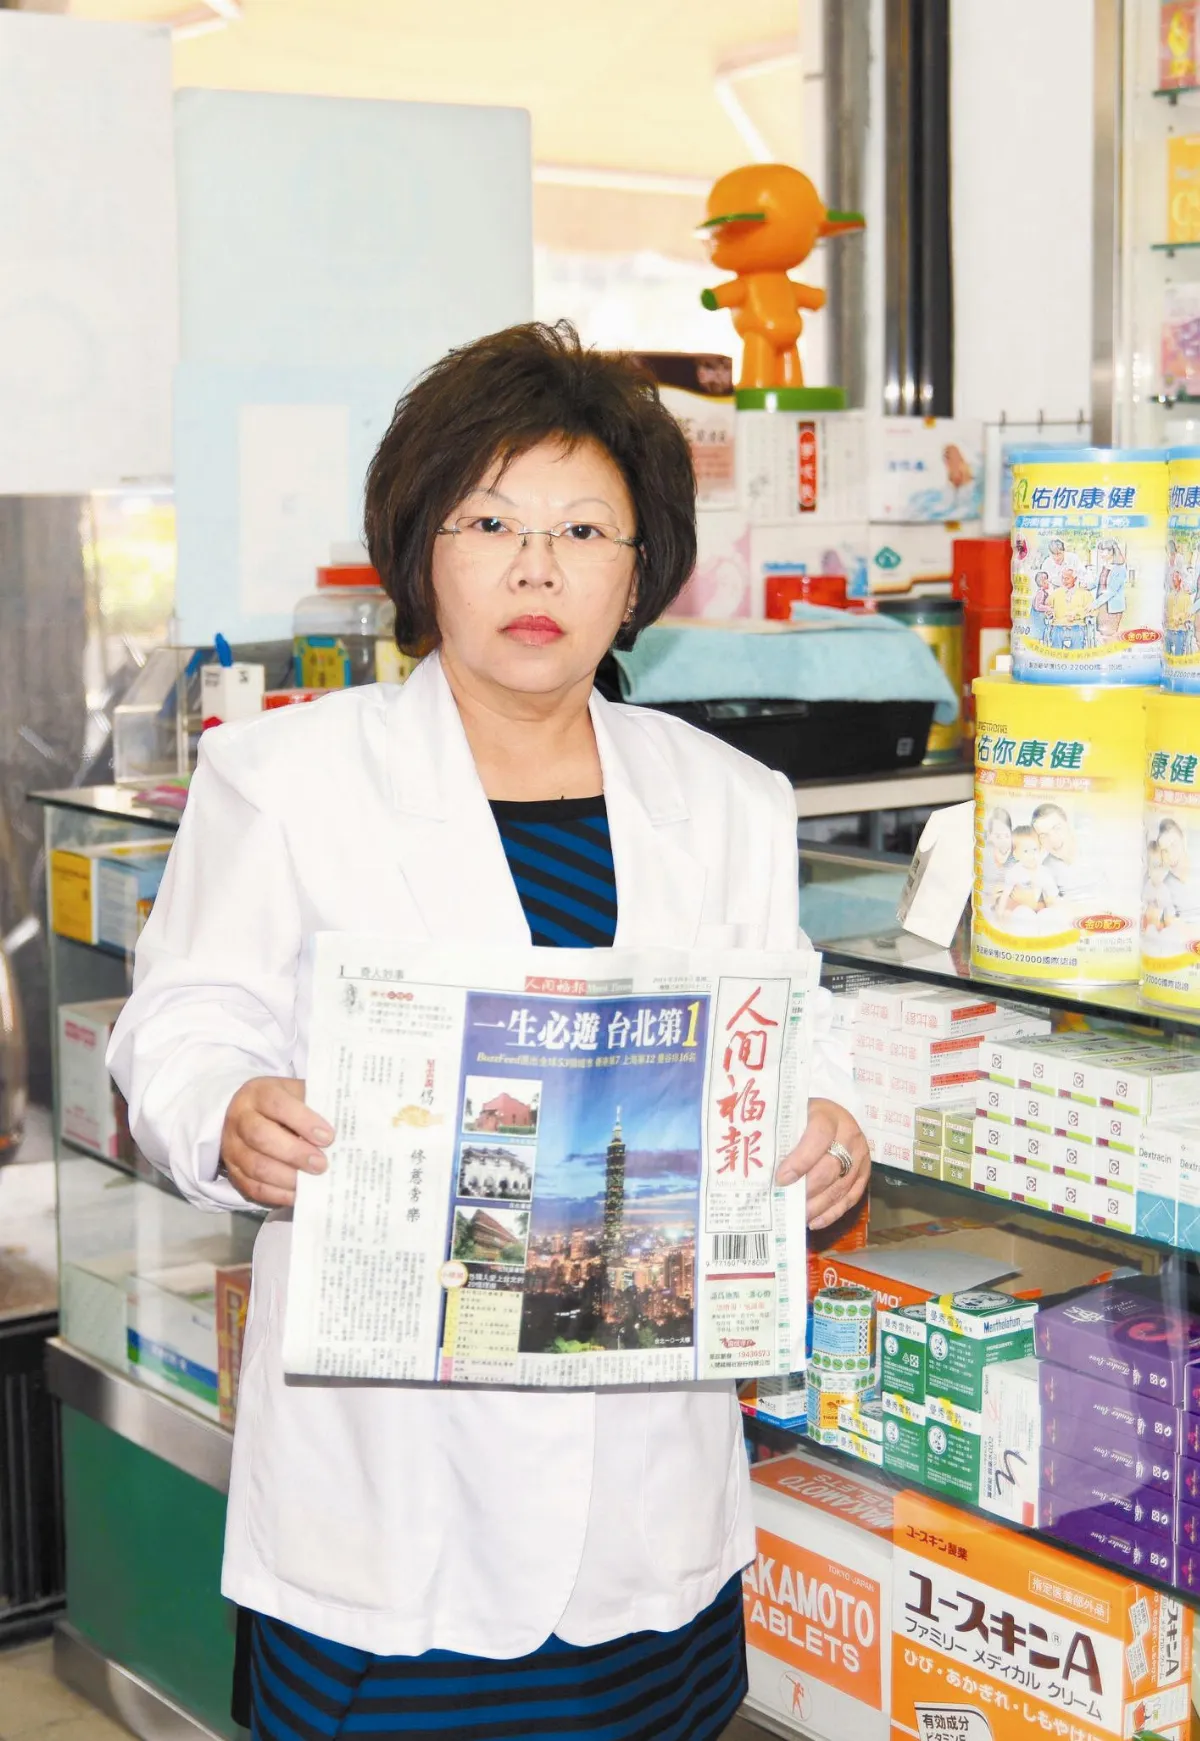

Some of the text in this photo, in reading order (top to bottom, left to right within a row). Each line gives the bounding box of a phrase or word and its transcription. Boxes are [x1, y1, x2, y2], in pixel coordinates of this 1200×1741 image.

[1031, 487, 1135, 509] 佑你康健
[1148, 751, 1198, 784] 康健
[1084, 919, 1122, 930] 金の配方
[1139, 1148, 1172, 1163] Dextracin
[906, 1525, 968, 1561] ユースキン製薬
[828, 1565, 875, 1593] TOKYO JAPAN
[742, 1553, 874, 1648] AKAMOTO
[744, 1595, 860, 1673] ABLETS
[905, 1617, 1102, 1721] ファミリー メディカル クリーム
[922, 1713, 969, 1731] 有効成分
